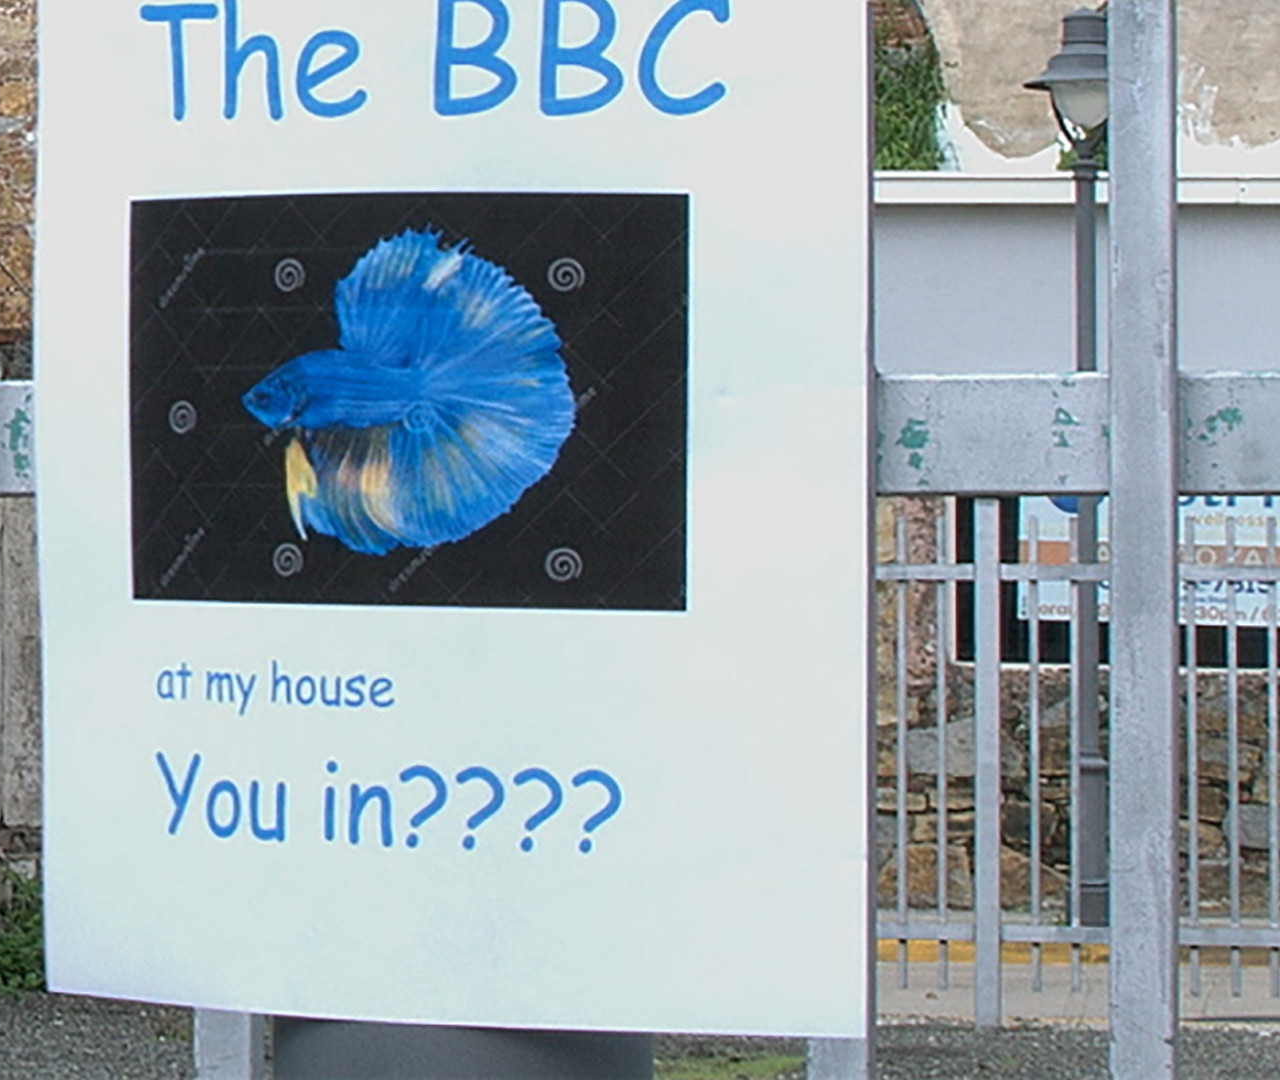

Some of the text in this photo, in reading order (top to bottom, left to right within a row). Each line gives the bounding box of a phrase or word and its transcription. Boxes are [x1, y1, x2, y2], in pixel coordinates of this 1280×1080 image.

[156, 660, 396, 717] at my house
[154, 751, 626, 855] You in????
